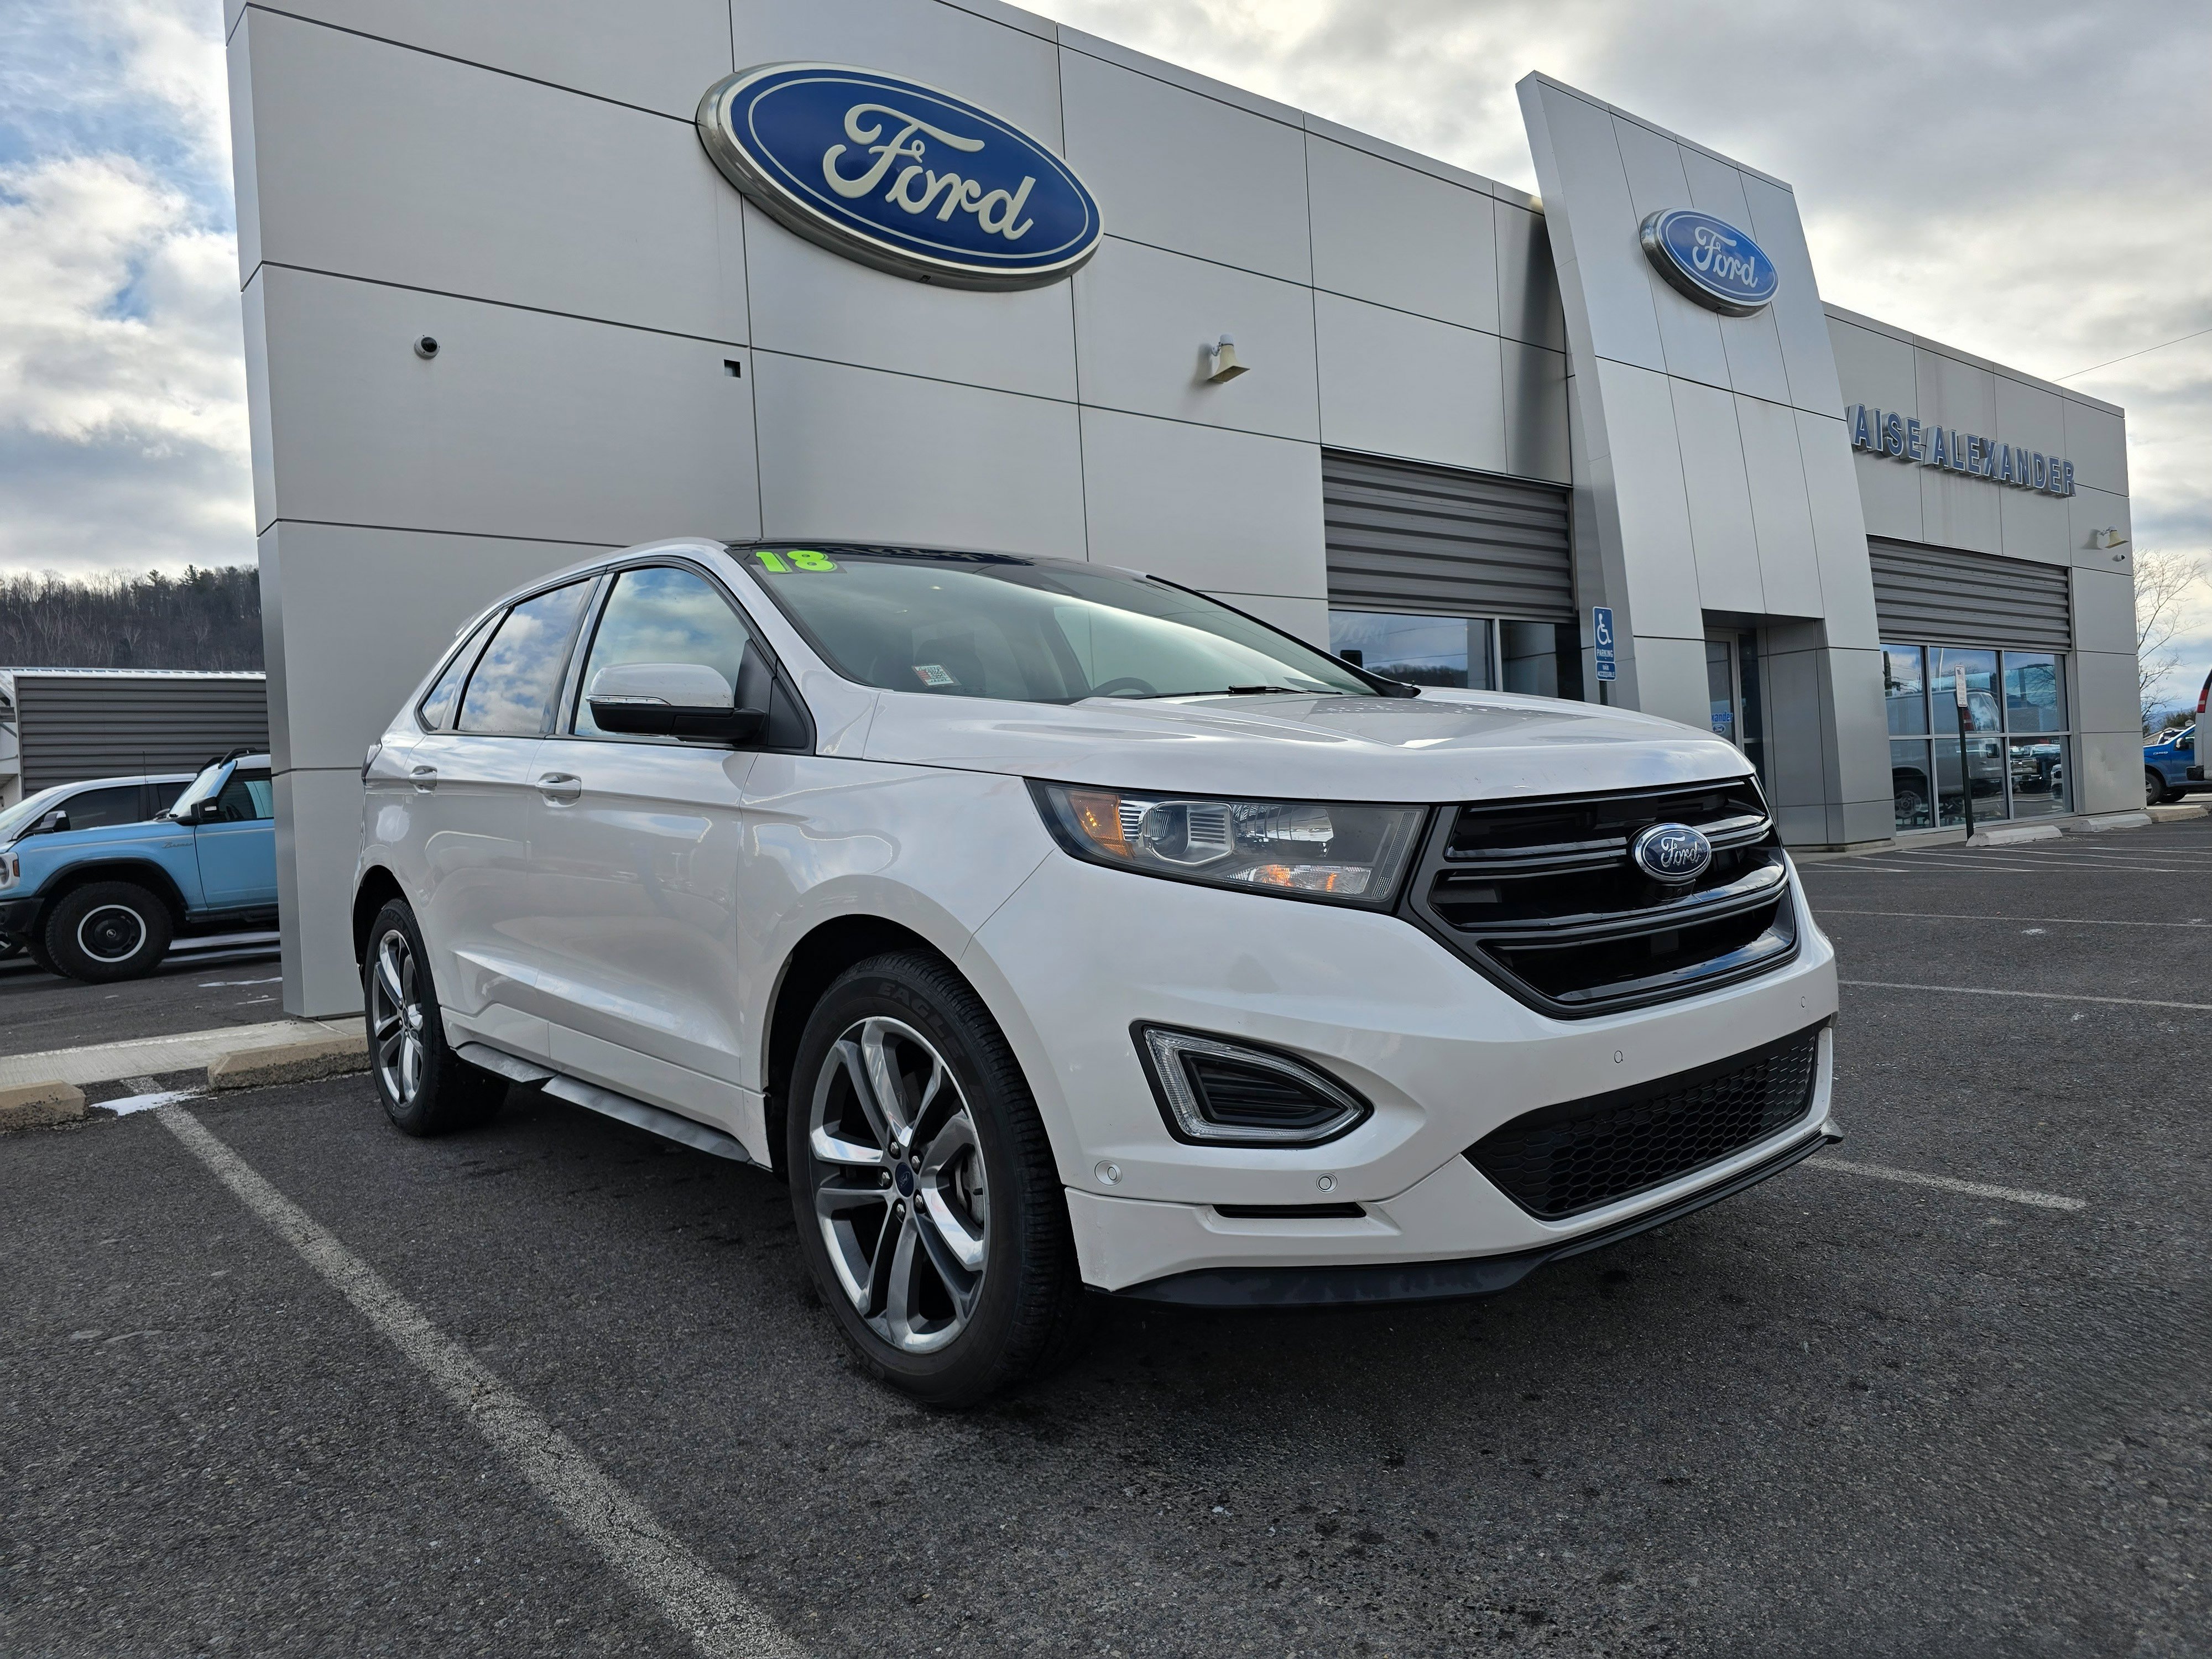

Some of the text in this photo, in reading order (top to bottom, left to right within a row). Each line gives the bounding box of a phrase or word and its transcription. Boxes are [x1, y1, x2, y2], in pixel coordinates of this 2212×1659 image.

[823, 103, 1036, 241] Ford
[1692, 226, 1758, 288] Ford
[1924, 424, 2077, 497] ALEXANDER
[755, 550, 837, 572] 18
[1661, 836, 1700, 868] Ford
[877, 981, 965, 1058] EAGLE
